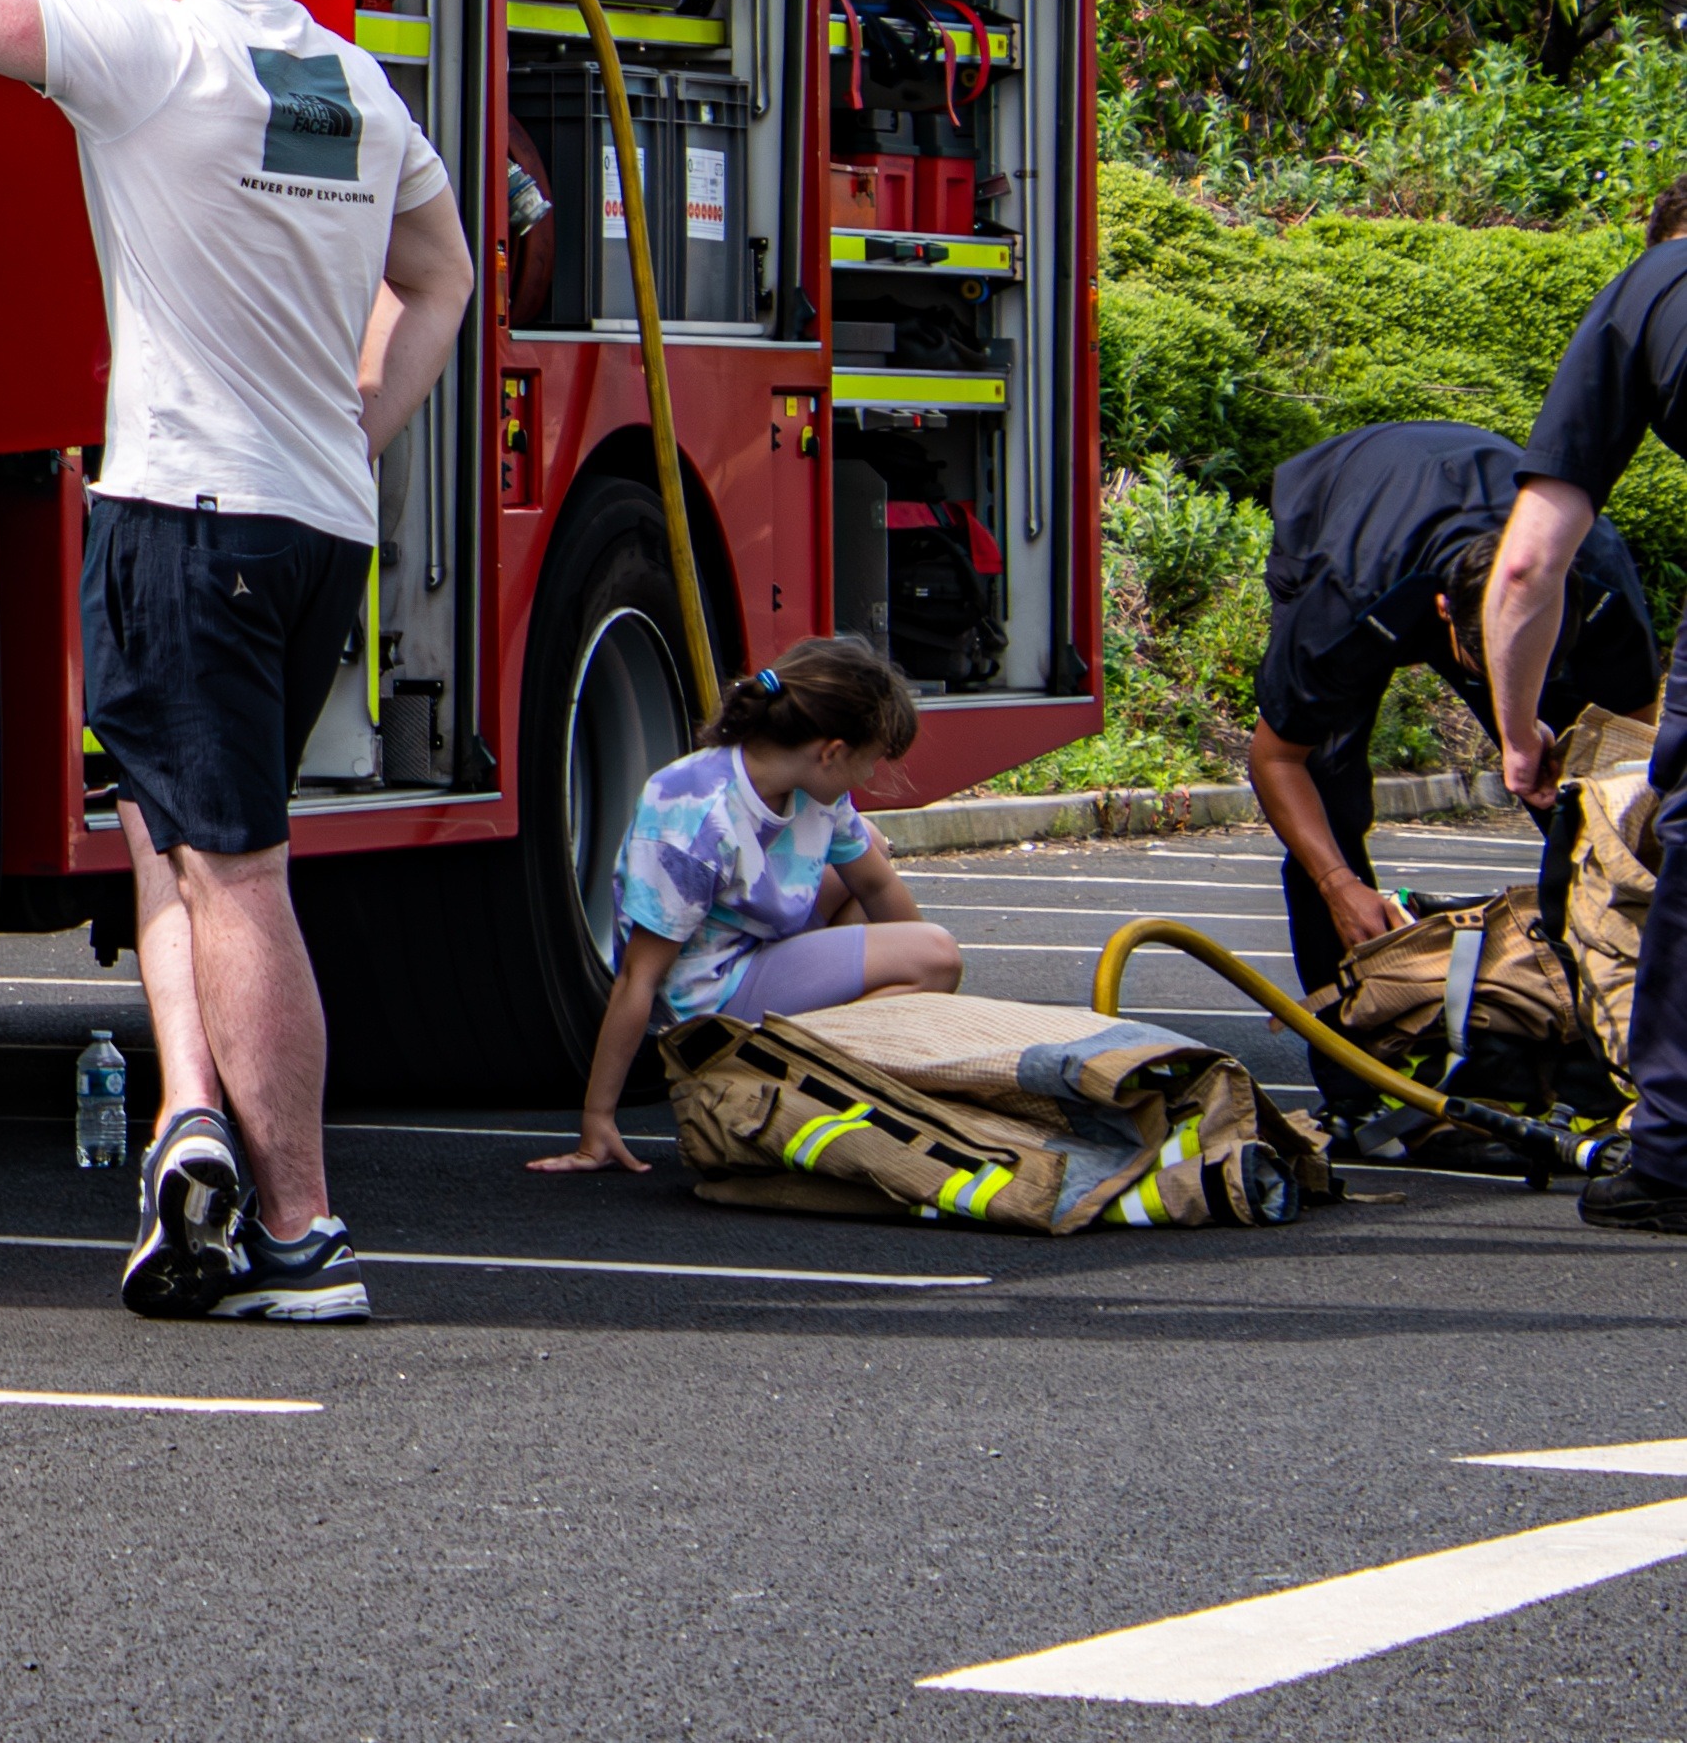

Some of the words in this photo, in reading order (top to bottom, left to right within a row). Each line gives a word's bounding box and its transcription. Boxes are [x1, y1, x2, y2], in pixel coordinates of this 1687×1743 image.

[282, 102, 330, 119] NORTH
[292, 117, 330, 135] FACE
[240, 177, 283, 194] NEVER
[287, 185, 314, 199] STOP
[317, 190, 376, 205] EXPLORING
